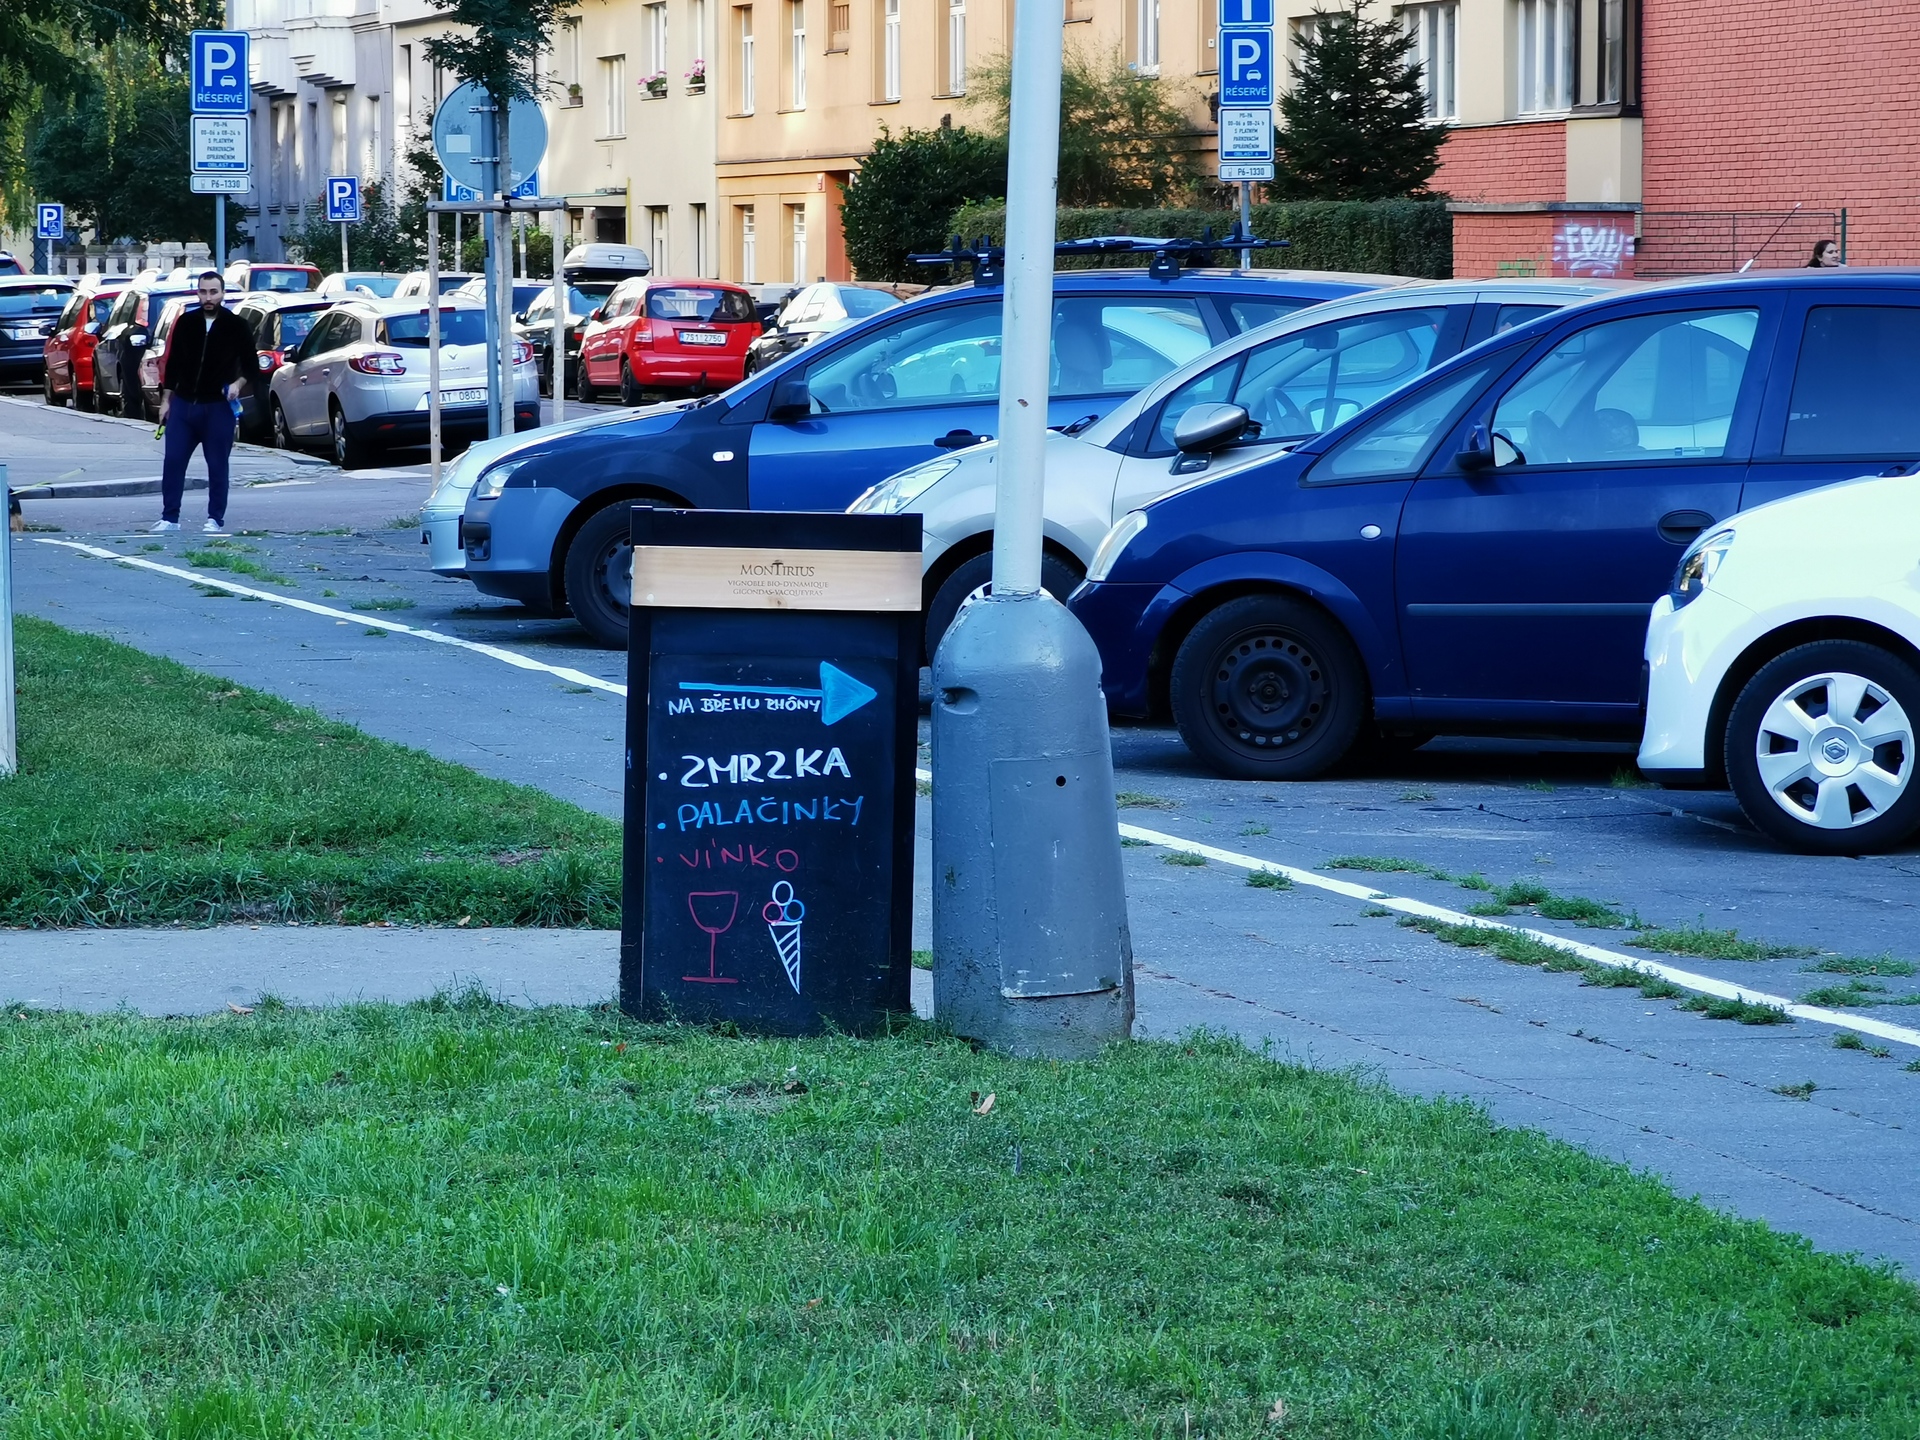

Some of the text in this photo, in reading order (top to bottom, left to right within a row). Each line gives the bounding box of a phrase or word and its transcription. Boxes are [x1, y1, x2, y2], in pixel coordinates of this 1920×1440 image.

[204, 42, 236, 87] P
[1231, 38, 1261, 81] P
[1225, 85, 1267, 96] RÉSERVÉ
[197, 91, 243, 104] RÉSERVÉ
[1237, 168, 1265, 176] P6-1330
[211, 179, 241, 189] P6-1330
[333, 182, 352, 208] P
[43, 208, 58, 228] P
[685, 333, 722, 342] 7S1 2750
[438, 390, 482, 403] AT 0803
[727, 579, 829, 589] VIGNOBLE BIO-DYNAMIQUE
[668, 697, 695, 715] NA
[677, 795, 865, 831] PALAČINKY
